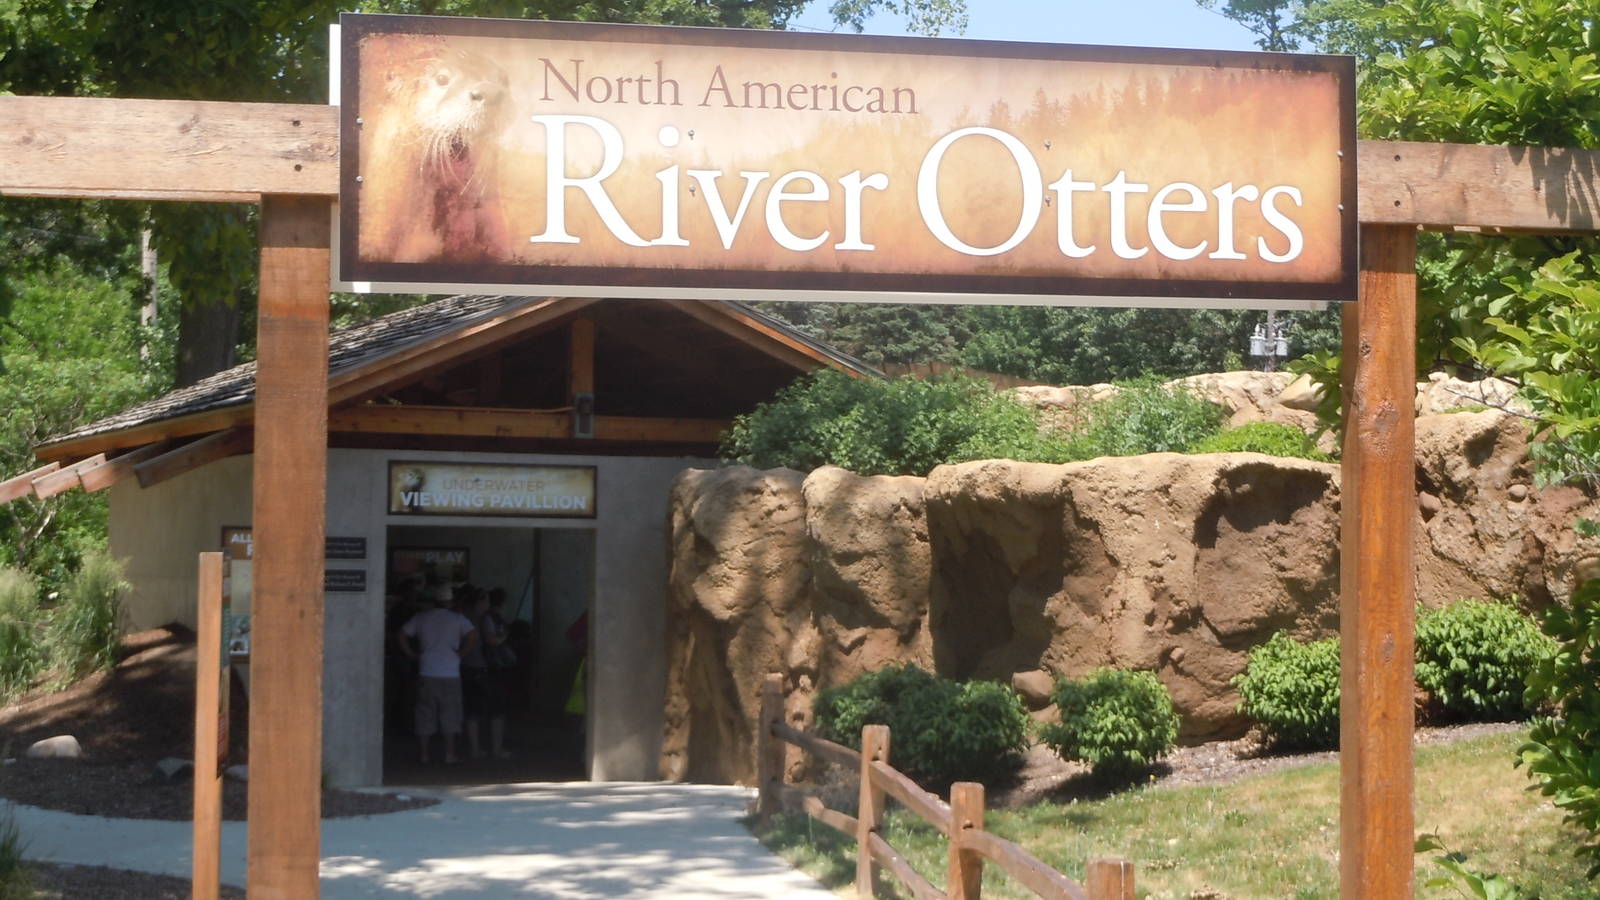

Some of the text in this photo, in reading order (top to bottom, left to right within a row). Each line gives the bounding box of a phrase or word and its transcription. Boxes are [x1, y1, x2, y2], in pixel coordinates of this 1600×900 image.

[538, 57, 919, 115] North American
[529, 114, 1304, 263] River Otters
[442, 479, 545, 492] UNDERWATER
[400, 491, 587, 510] VIEWING PAVILLION
[425, 550, 464, 564] PLAY
